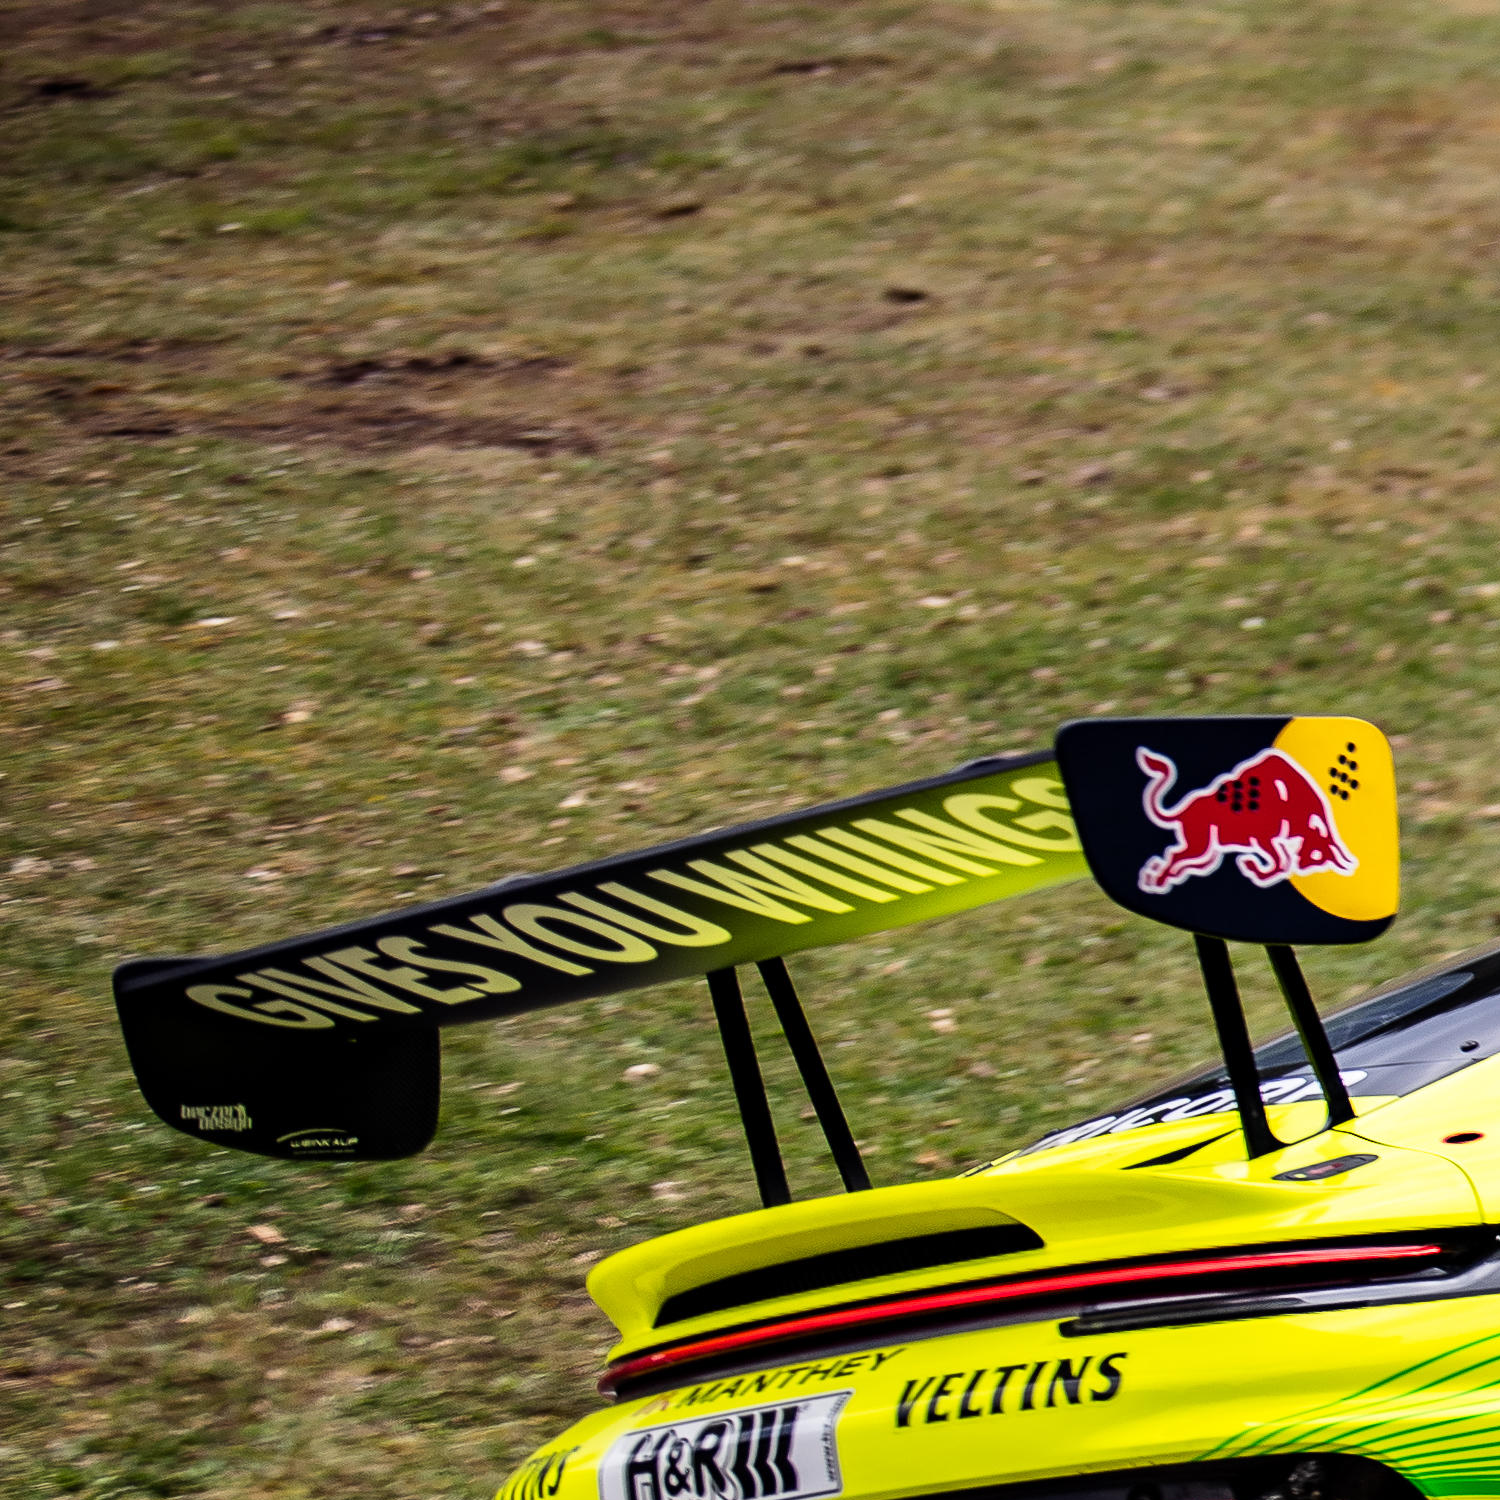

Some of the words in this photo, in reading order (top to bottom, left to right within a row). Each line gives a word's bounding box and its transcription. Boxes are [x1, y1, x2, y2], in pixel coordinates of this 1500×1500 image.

[186, 936, 523, 1029] GIVES
[429, 881, 732, 976] YOU
[646, 775, 1085, 926] WINGS
[676, 1349, 906, 1408] MANTHEY
[894, 1352, 1128, 1429] VELTINS
